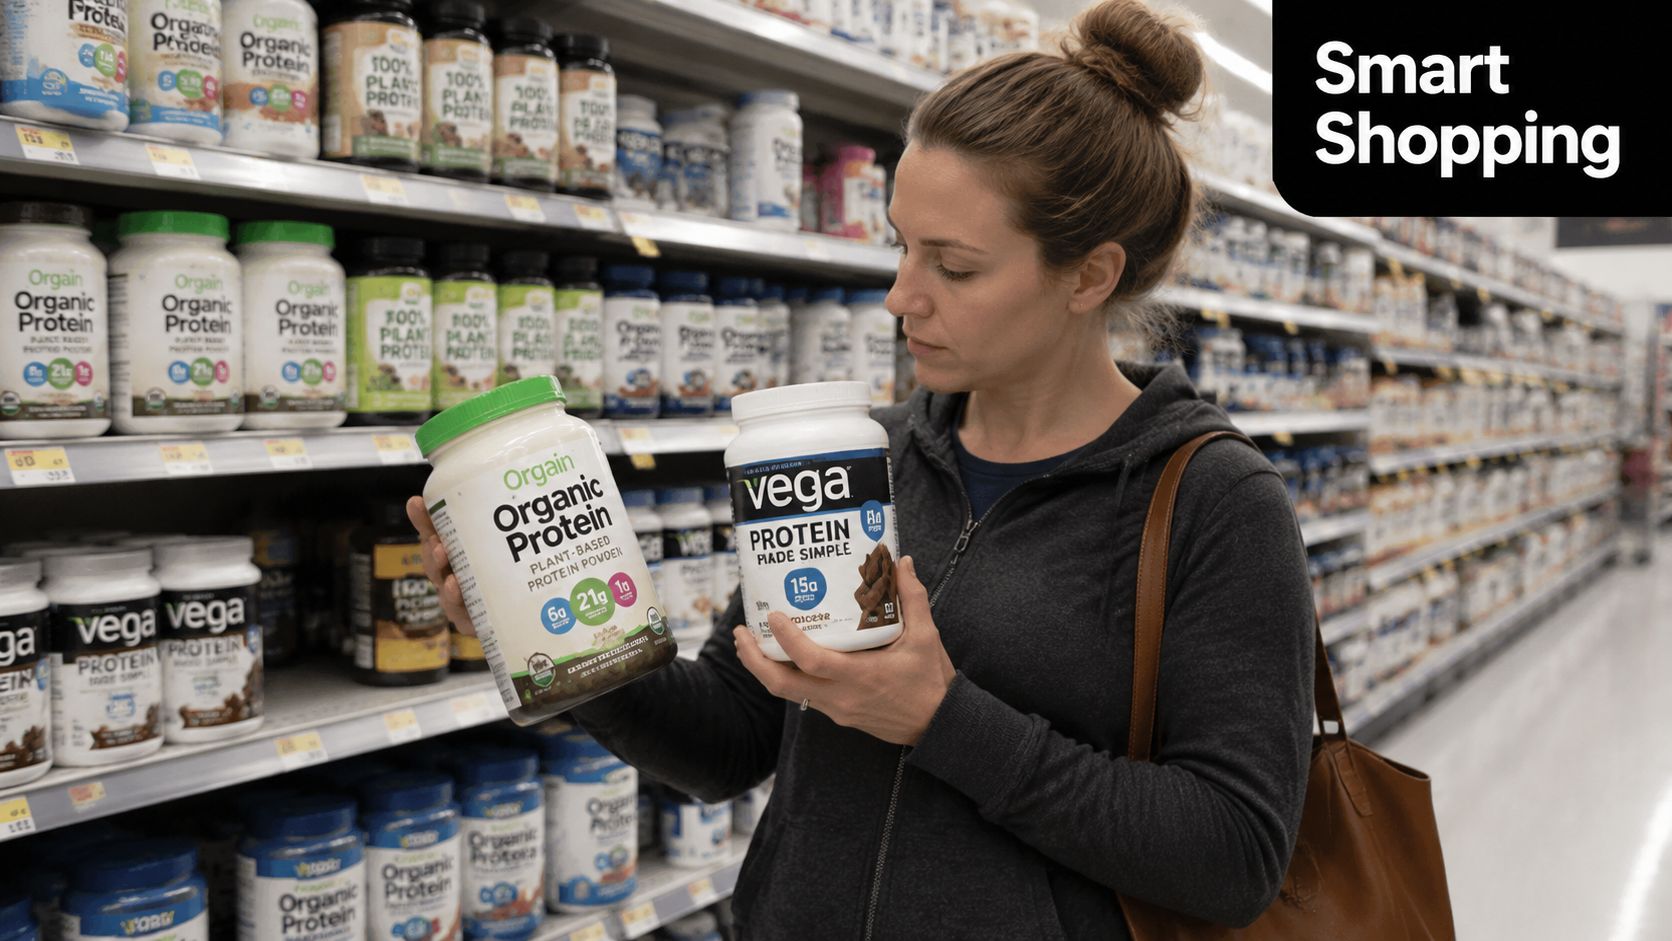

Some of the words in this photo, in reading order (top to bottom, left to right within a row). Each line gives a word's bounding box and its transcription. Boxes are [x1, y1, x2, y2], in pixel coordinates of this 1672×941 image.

[242, 51, 310, 74] Protein
[29, 269, 83, 290] Orgain
[175, 274, 223, 294] Orgain
[15, 290, 95, 314] Organic
[162, 294, 233, 316] Organic
[275, 299, 338, 319] Organic
[19, 312, 94, 332] Protein
[165, 315, 232, 333] Protein
[279, 318, 338, 336] Protein
[503, 453, 575, 490] Orgain
[743, 466, 852, 512] vega
[493, 474, 604, 532] Organic
[505, 504, 613, 563] Protein
[750, 518, 850, 551] PROTEIN
[529, 535, 611, 575] PLANT-BASED
[800, 542, 852, 561] SIMPLE
[527, 562, 580, 592] PROTEIN
[577, 588, 609, 611] 21g
[166, 597, 245, 633] vega
[76, 609, 156, 647] vega
[168, 639, 239, 657] PROTEIN
[279, 885, 359, 914] Organic
[385, 878, 451, 900] Protein
[282, 907, 355, 934] Protein
